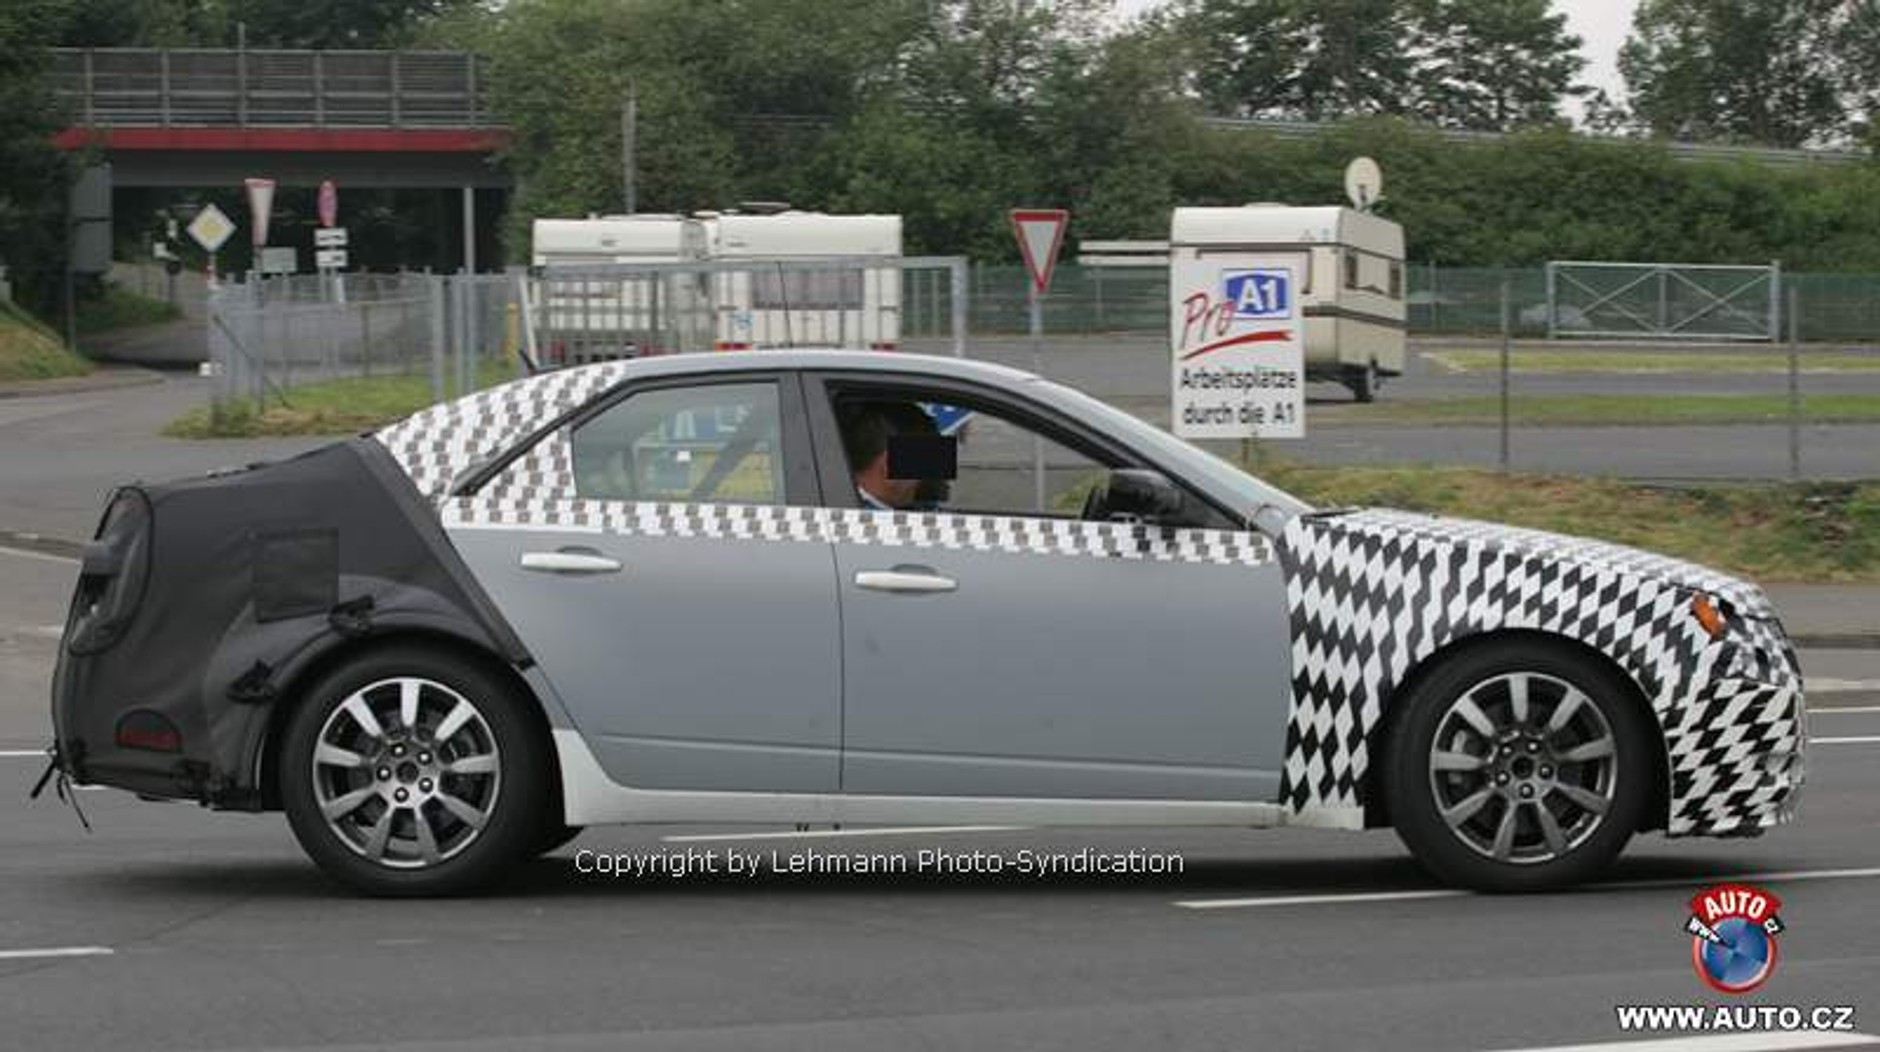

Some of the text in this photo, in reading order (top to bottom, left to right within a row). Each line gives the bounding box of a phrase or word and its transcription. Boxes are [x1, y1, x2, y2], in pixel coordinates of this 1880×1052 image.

[1181, 277, 1279, 350] Pro A1
[1180, 366, 1297, 395] Arbeitsplätze
[1183, 401, 1295, 425] durch die A1
